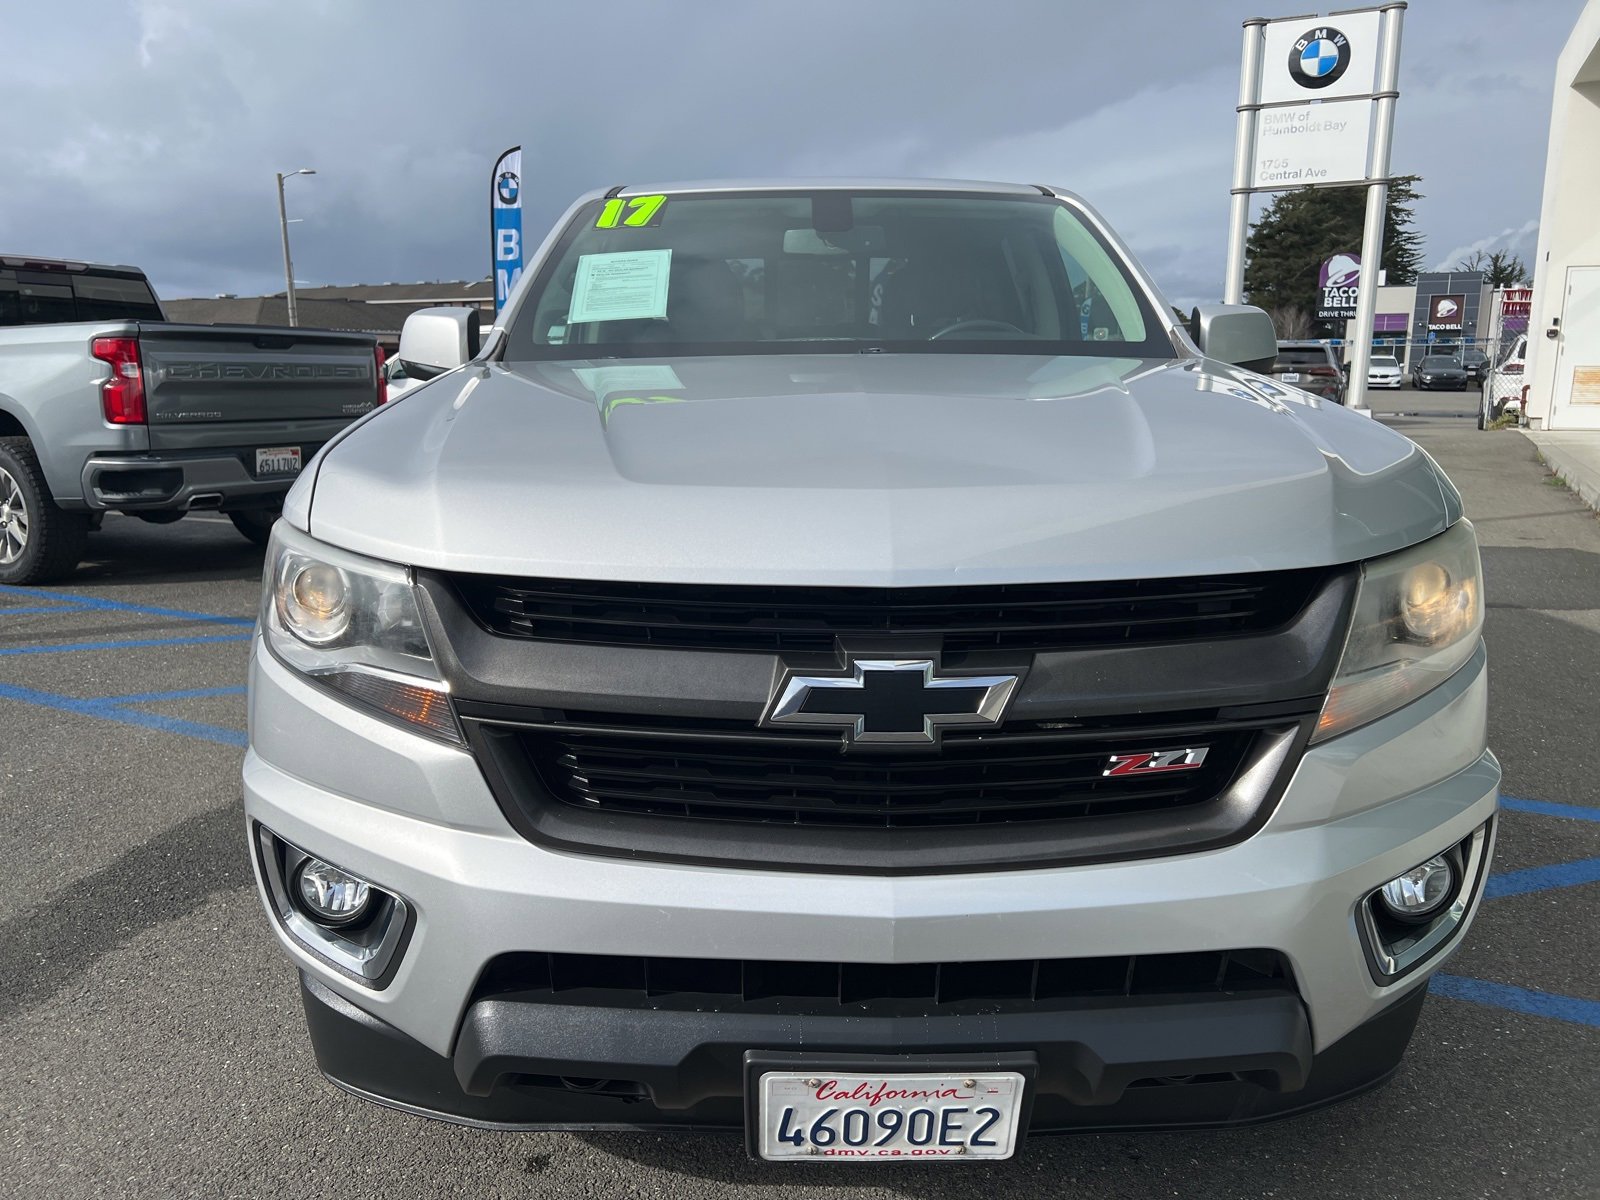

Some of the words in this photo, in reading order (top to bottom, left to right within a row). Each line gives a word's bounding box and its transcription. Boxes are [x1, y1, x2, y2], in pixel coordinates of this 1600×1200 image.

[1295, 28, 1347, 51] BMW
[1264, 112, 1296, 125] BMW
[1298, 111, 1311, 121] of
[1323, 120, 1347, 134] Bay
[1260, 169, 1302, 181] Central
[1305, 168, 1327, 178] Ave
[596, 194, 667, 229] 17
[1323, 286, 1358, 297] TACO
[1324, 297, 1357, 307] BELL
[1318, 310, 1339, 318] DRIVE
[1102, 747, 1210, 776] Z71
[815, 1080, 974, 1107] California
[777, 1107, 1001, 1147] 46090E2
[823, 1147, 952, 1157] dmv.ca.gov
